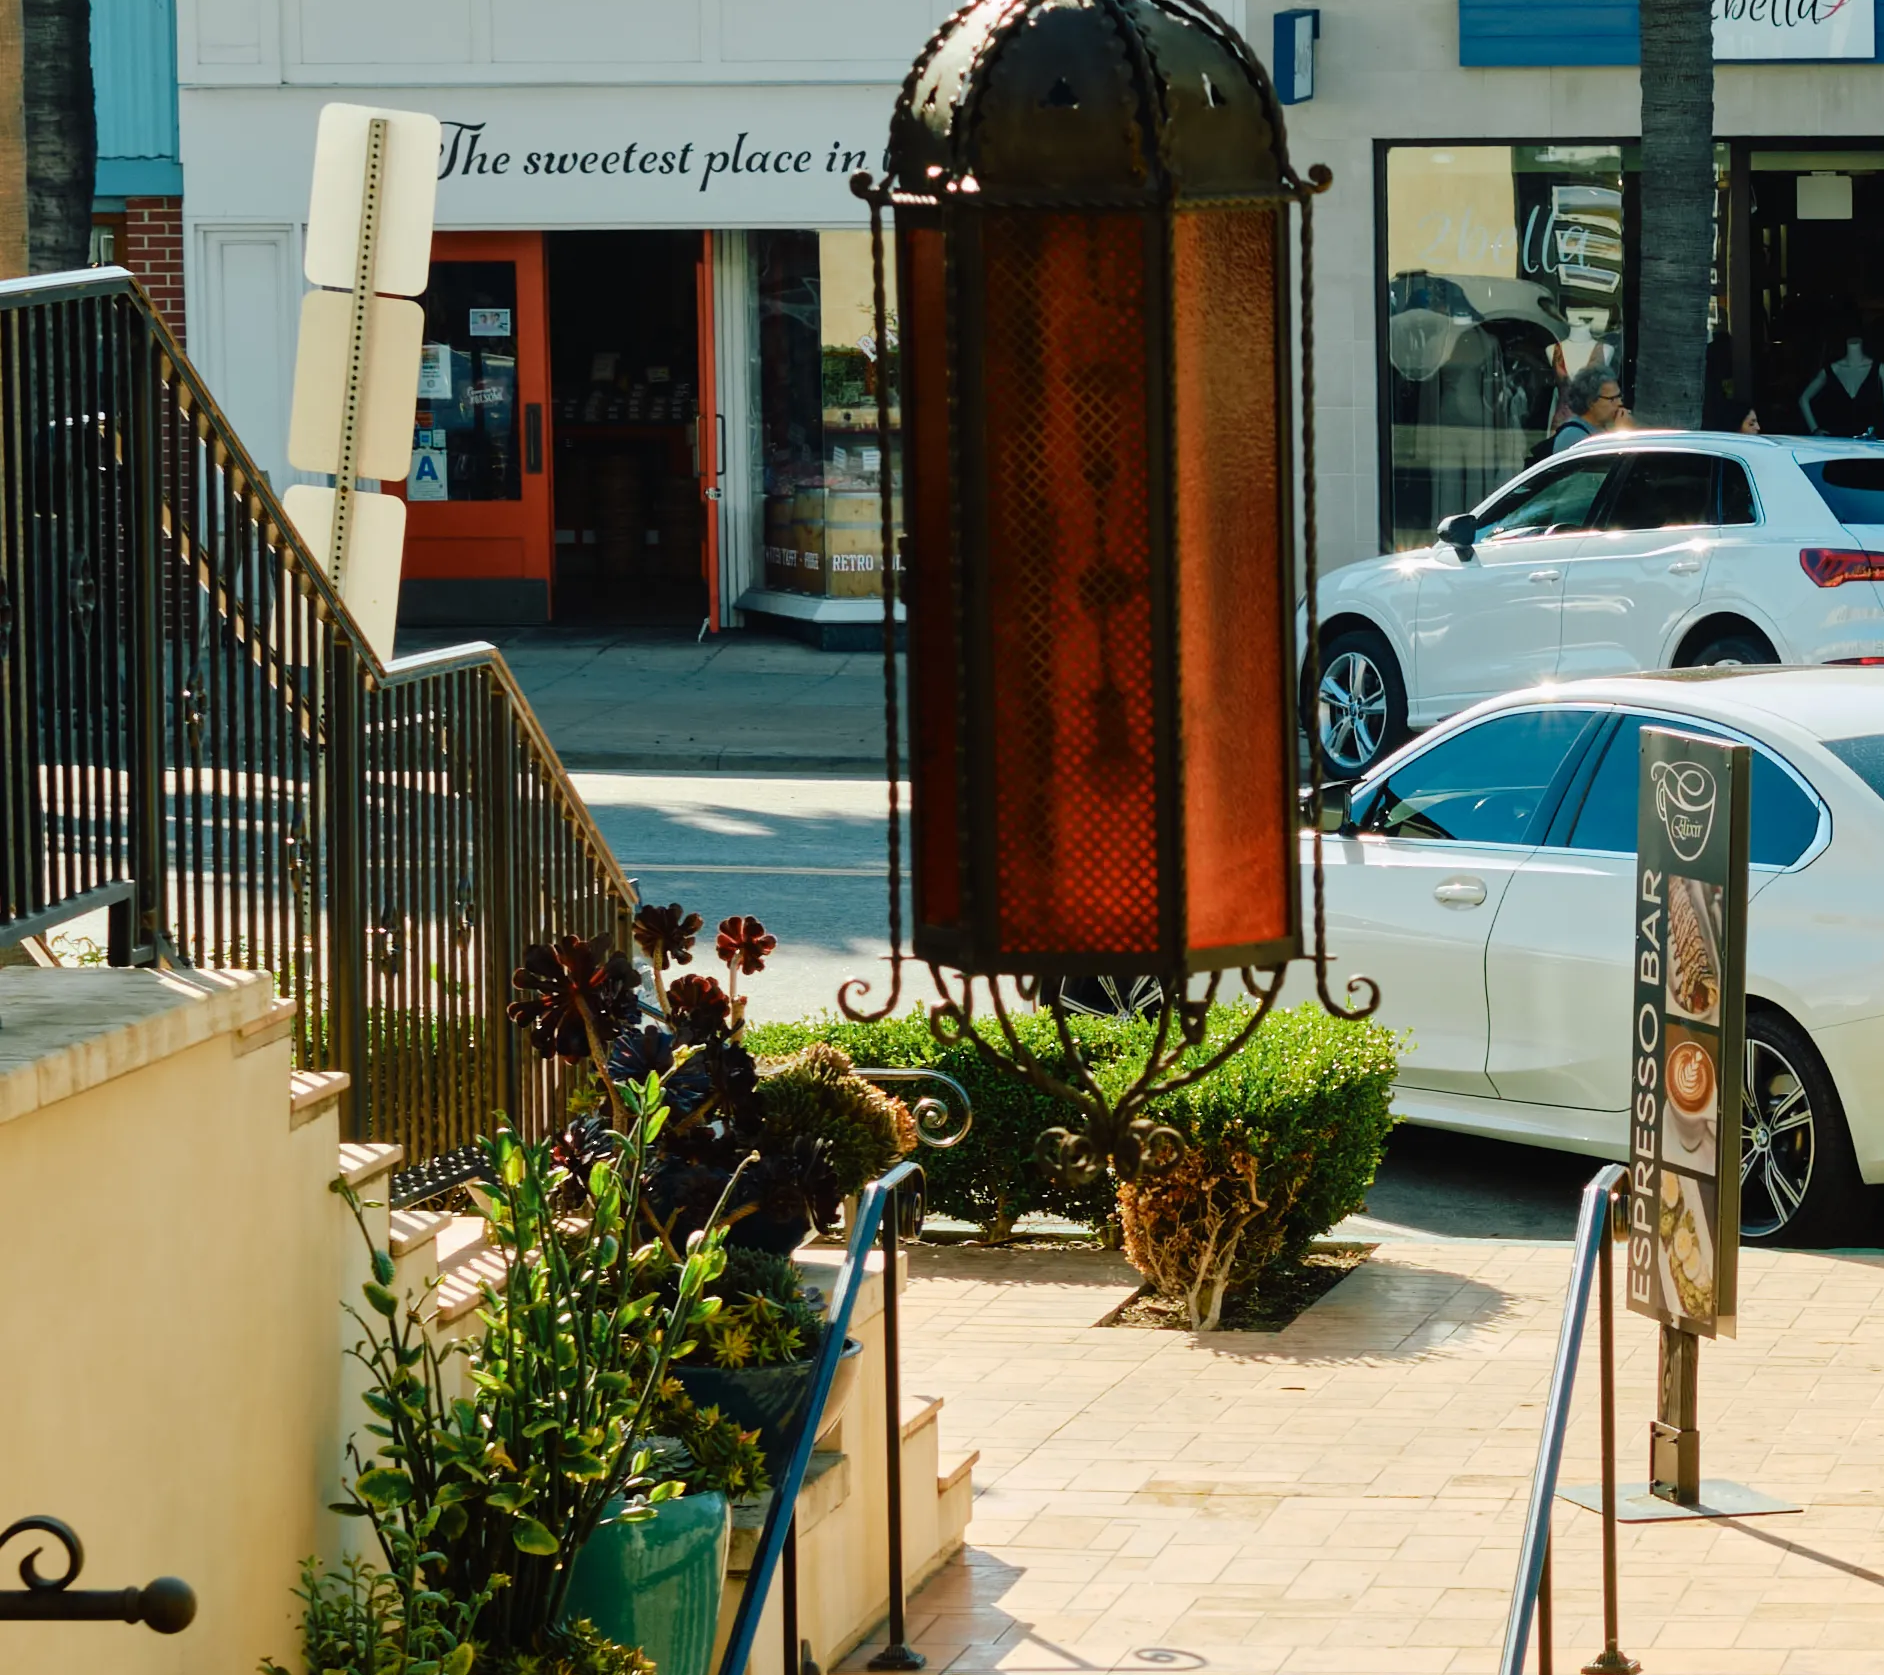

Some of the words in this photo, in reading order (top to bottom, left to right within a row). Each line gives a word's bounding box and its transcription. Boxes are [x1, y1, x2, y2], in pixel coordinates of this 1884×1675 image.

[438, 122, 510, 180] The
[523, 141, 694, 175] sweetest
[699, 132, 812, 192] place
[826, 141, 867, 173] in
[1417, 204, 1592, 274] 2bella
[416, 456, 439, 480] A
[832, 553, 874, 572] RETRO
[1640, 868, 1662, 986] BAR
[1631, 1002, 1659, 1305] ESPRESSO
